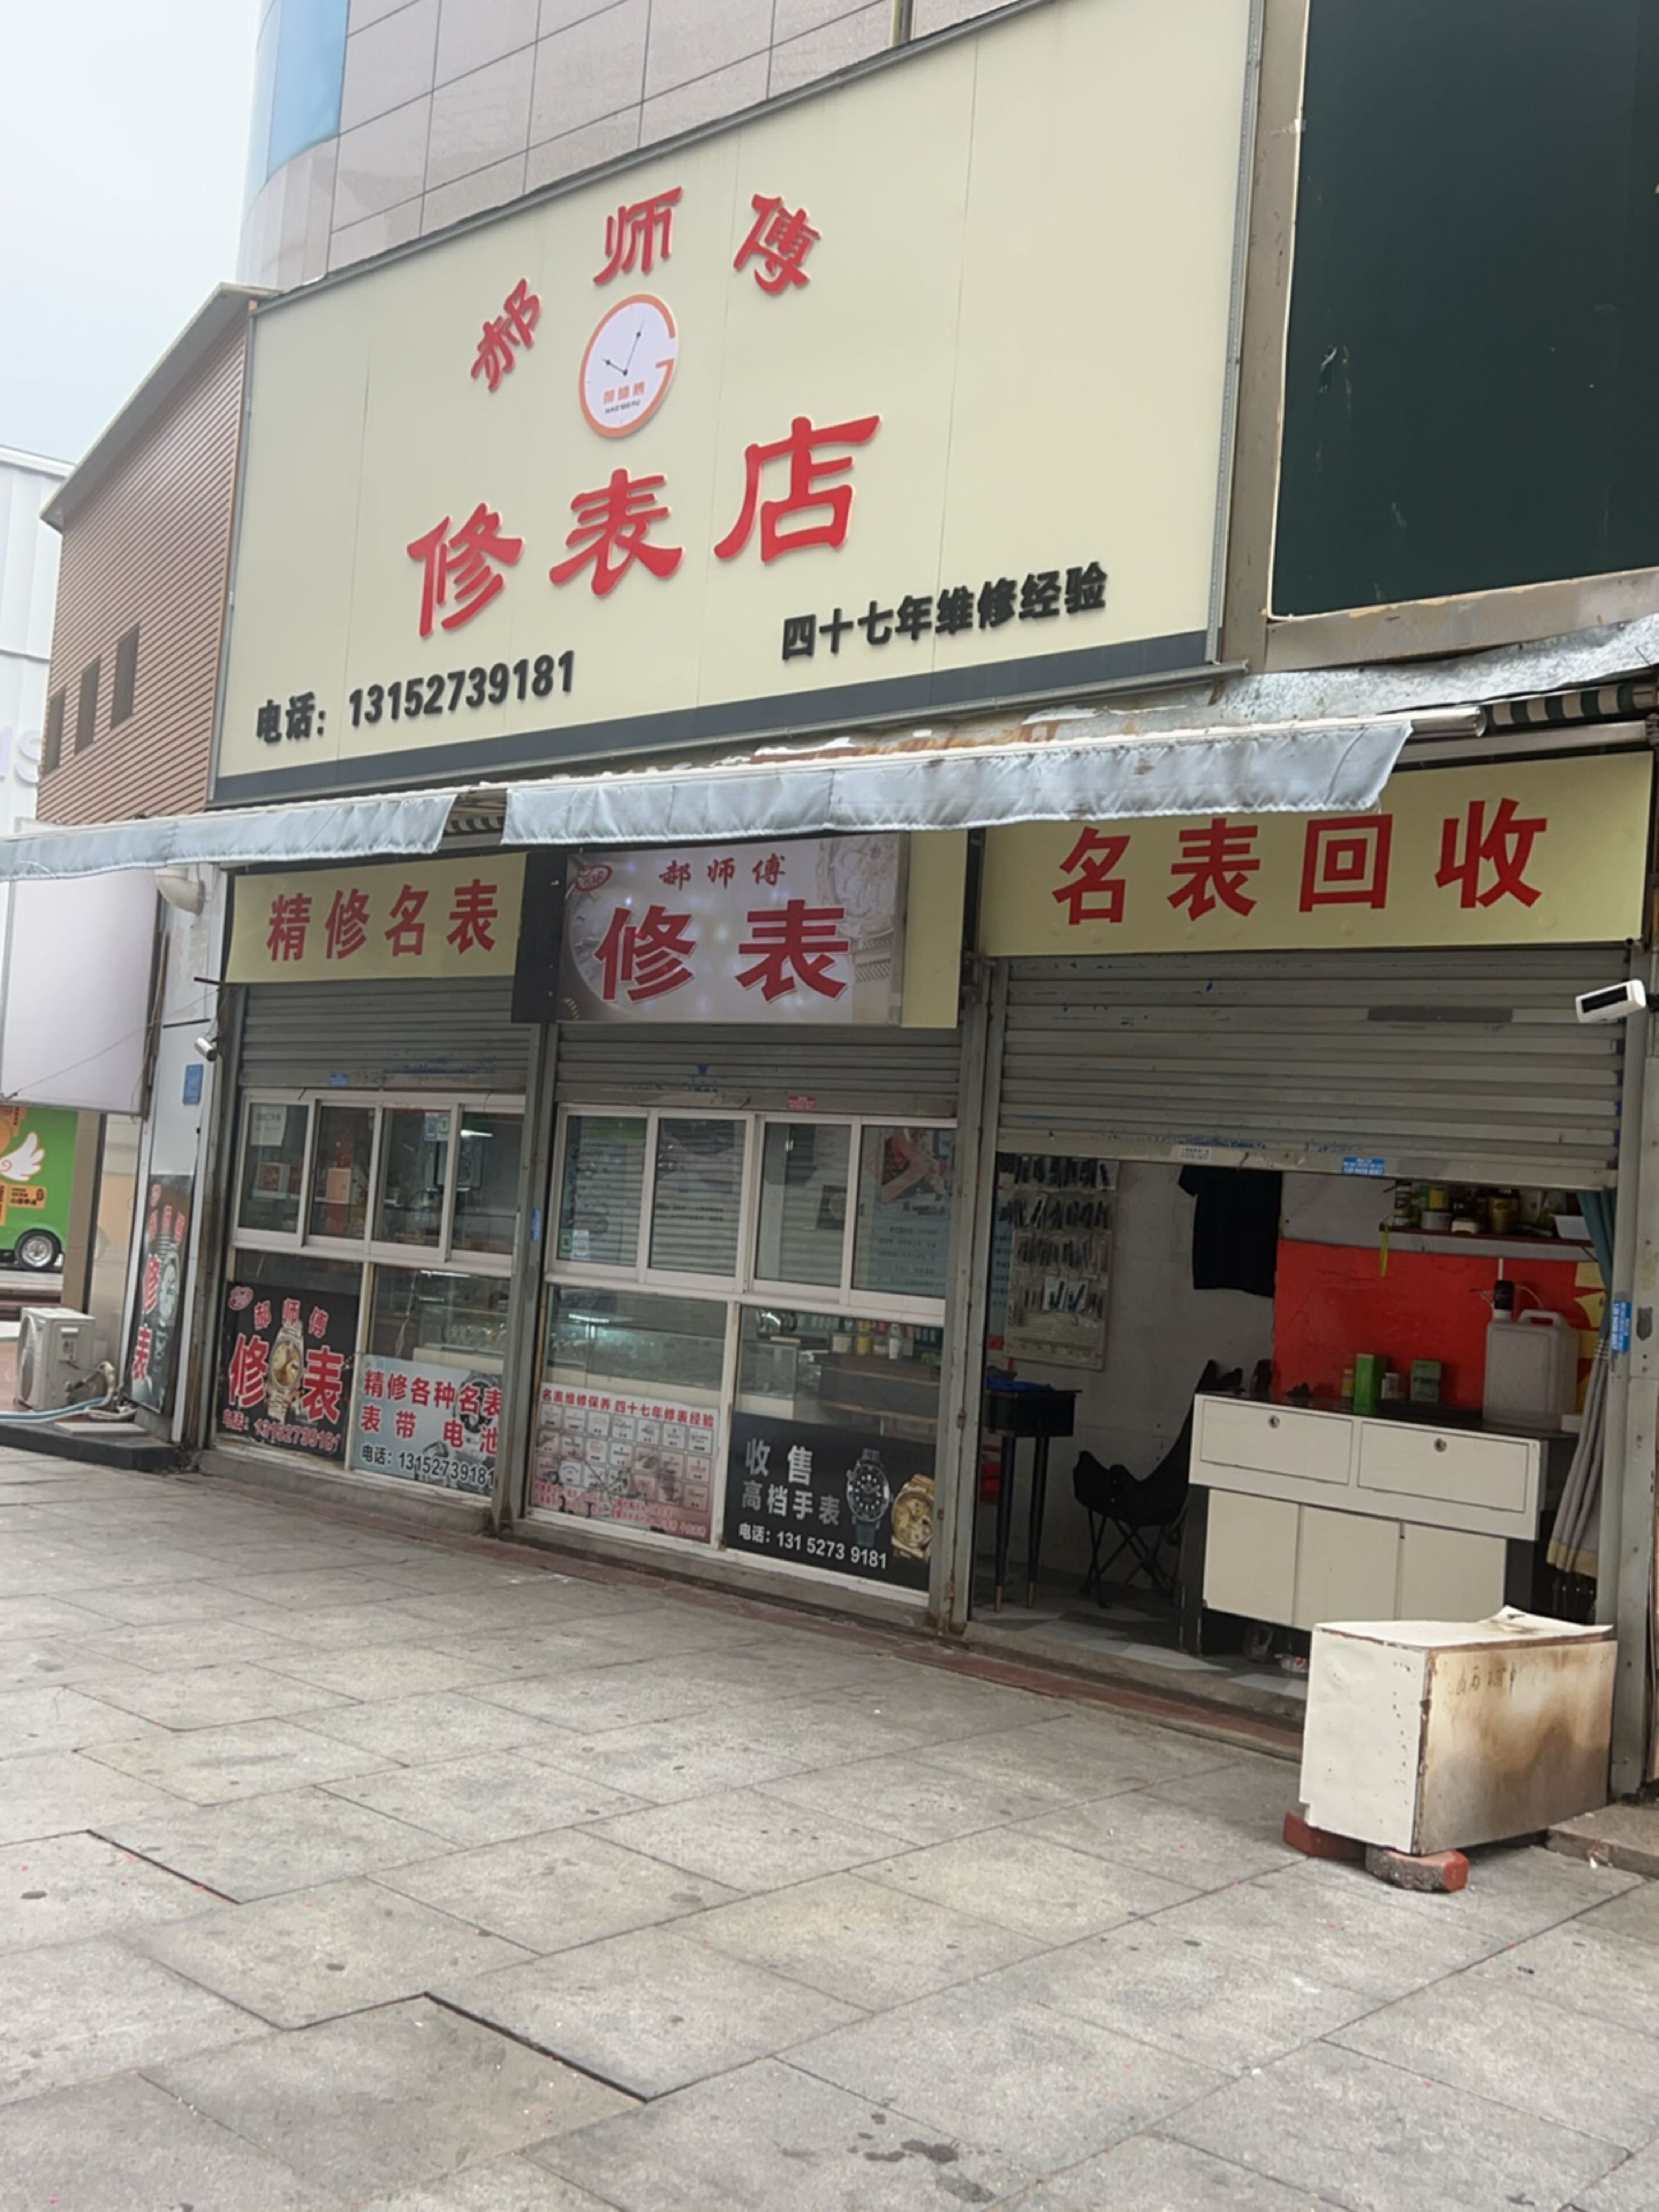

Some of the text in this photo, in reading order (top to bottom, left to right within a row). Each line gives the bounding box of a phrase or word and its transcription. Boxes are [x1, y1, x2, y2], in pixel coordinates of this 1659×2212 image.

[470, 186, 822, 391] 郝师傅
[406, 415, 881, 638] 修表店
[780, 561, 1108, 661] 四十七年维修经验
[348, 650, 575, 728] 13152739181
[659, 853, 785, 890] 郝师傅
[1052, 797, 1548, 926] 名表回收
[266, 879, 499, 962] 精修名表
[594, 899, 850, 1002] 修表
[229, 1333, 344, 1424] 修表
[364, 1370, 502, 1416] 精修各种名表
[399, 1452, 495, 1486] 13152739181
[745, 1438, 813, 1486] 收售
[742, 1480, 840, 1525] 高档手表
[806, 1537, 845, 1560] 5273
[851, 1546, 886, 1569] 9181
